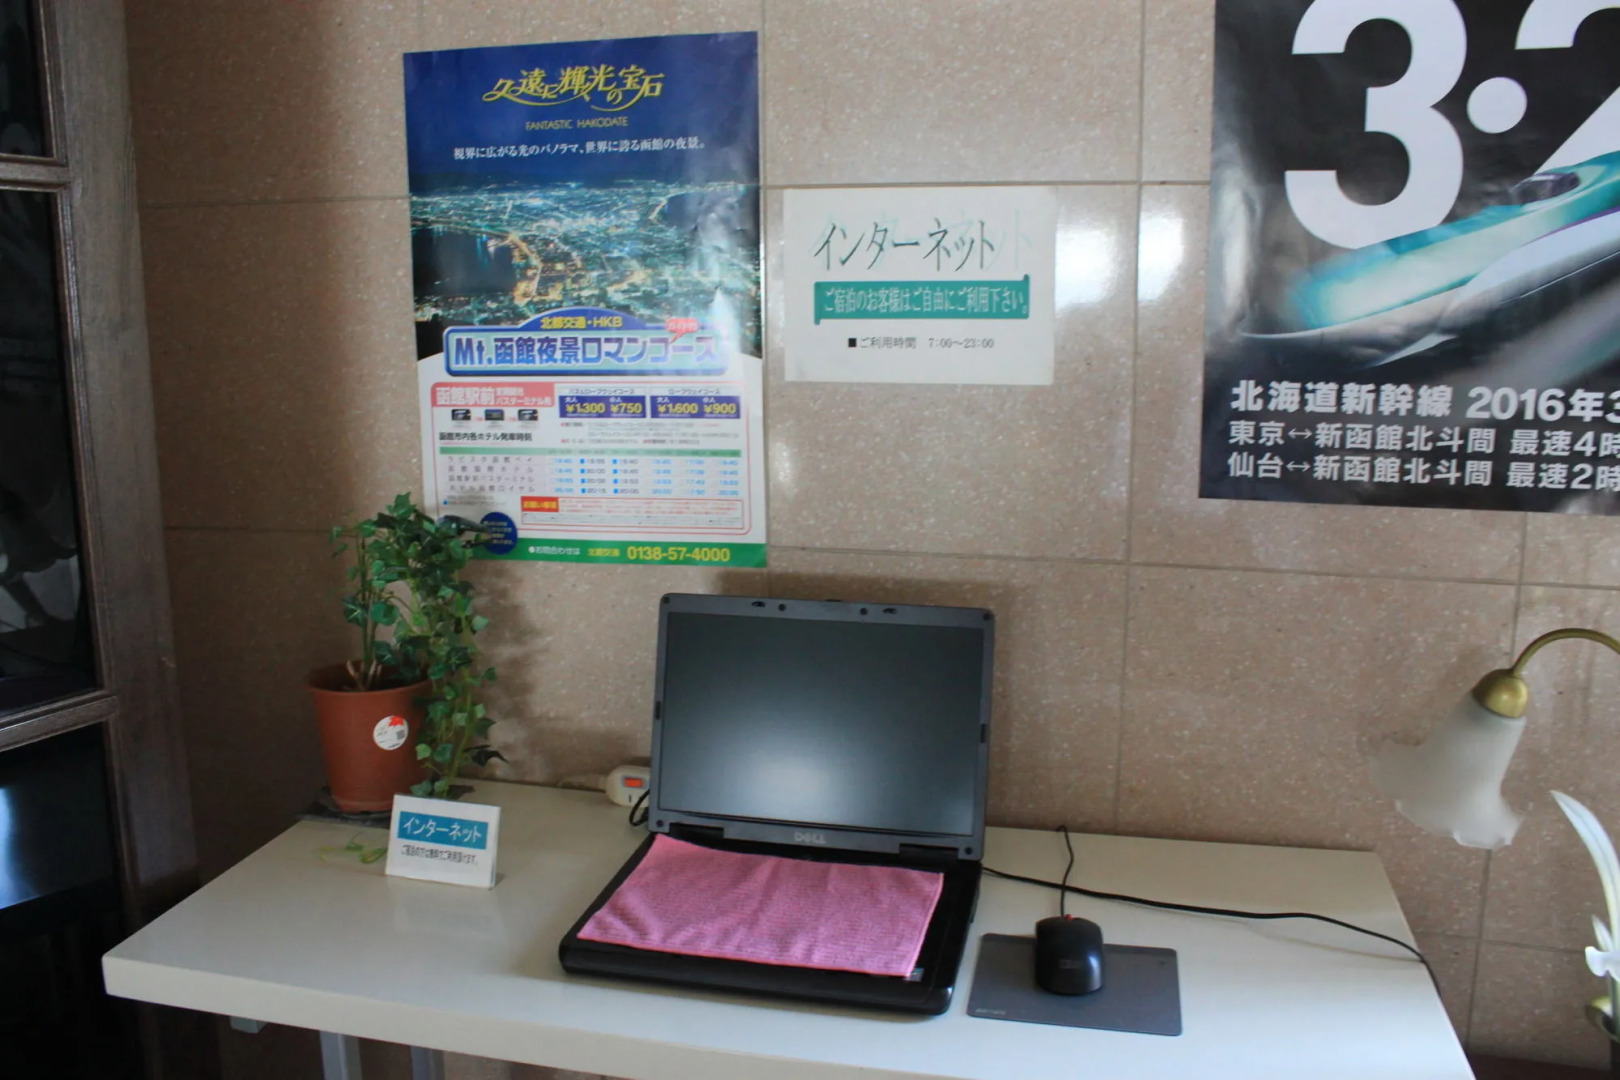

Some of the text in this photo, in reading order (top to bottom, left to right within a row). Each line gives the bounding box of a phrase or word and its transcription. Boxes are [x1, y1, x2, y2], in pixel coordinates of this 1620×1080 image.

[525, 116, 628, 131] FANTASTIC HAKODATE
[813, 216, 996, 272] インターネット
[860, 337, 916, 349] ご利用時間
[704, 402, 737, 415] ¥900
[1230, 379, 1453, 418] 北海道新幹線
[1228, 419, 1497, 454] 東京 新函館北斗間
[1227, 451, 1494, 487] 仙台 新函館北斗間
[627, 546, 731, 562] 0138-57-4000
[403, 816, 482, 843] インターネット
[794, 831, 827, 844] DELL
